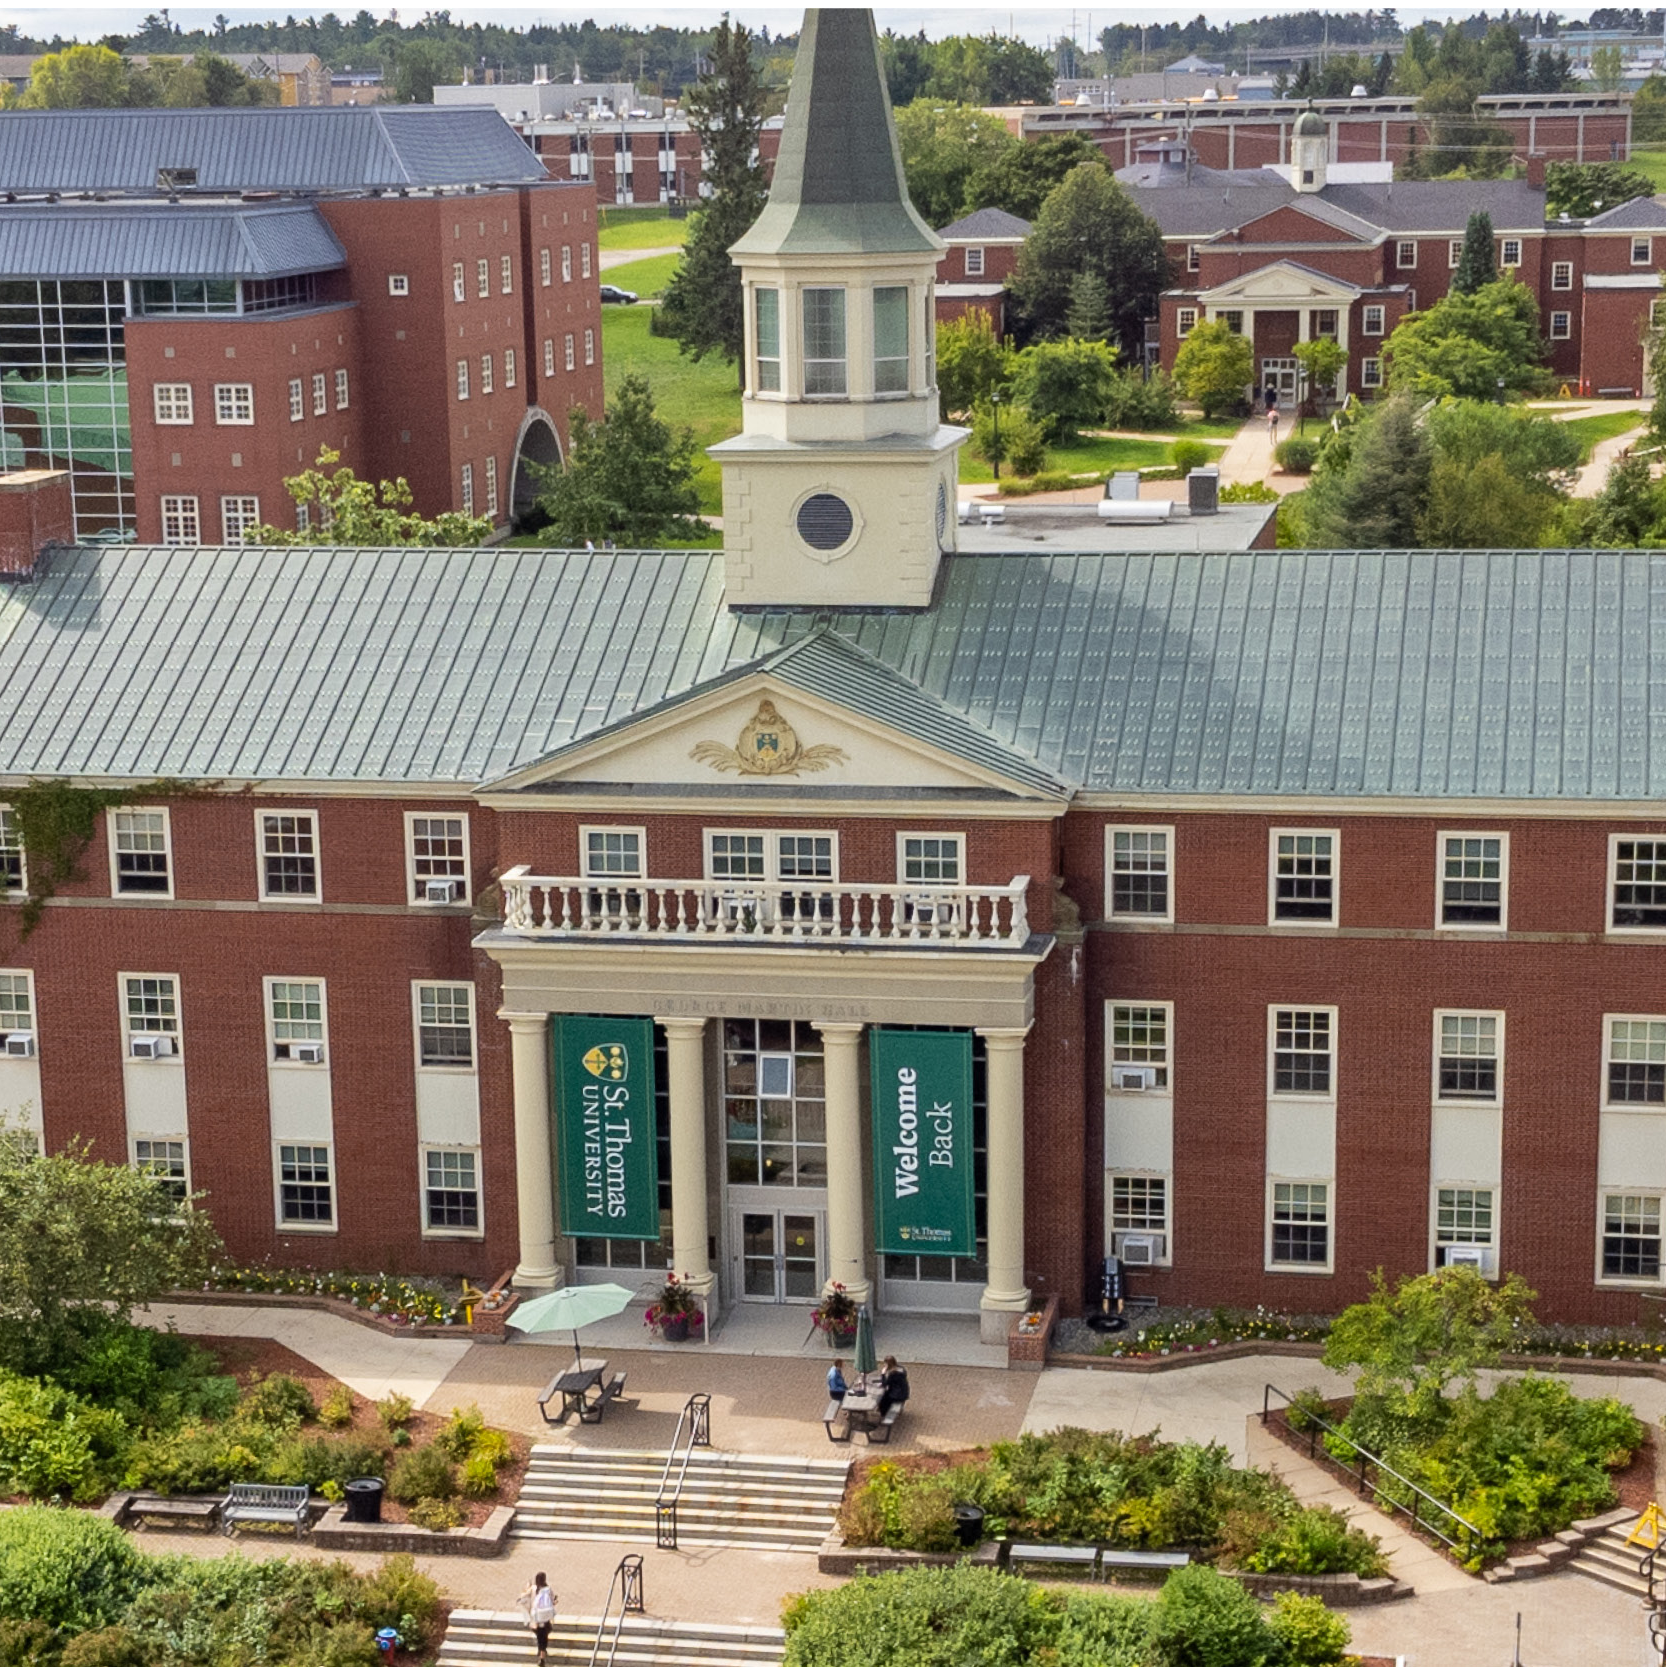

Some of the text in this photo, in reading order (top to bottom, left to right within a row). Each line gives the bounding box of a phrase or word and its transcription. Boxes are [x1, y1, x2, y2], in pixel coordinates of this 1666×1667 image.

[821, 1004, 871, 1017] HALL
[582, 1085, 604, 1217] UNIVERSITY
[602, 1086, 632, 1218] St. Thomas
[892, 1067, 920, 1199] Welcome
[925, 1101, 954, 1168] Back
